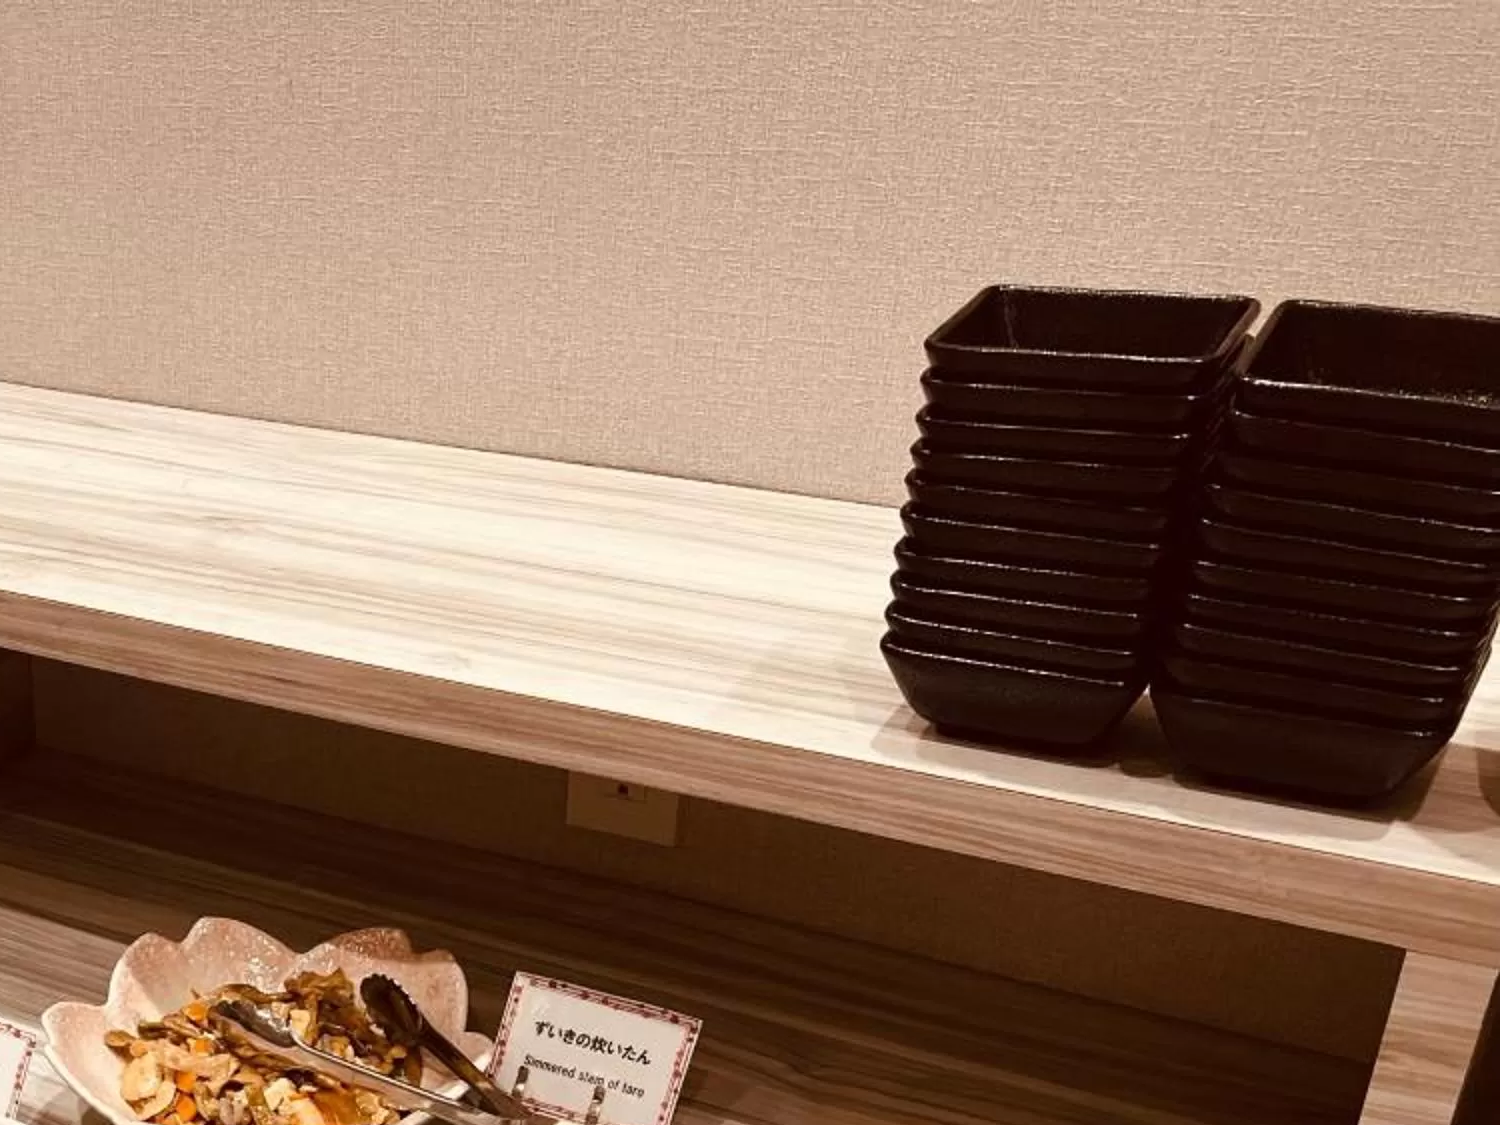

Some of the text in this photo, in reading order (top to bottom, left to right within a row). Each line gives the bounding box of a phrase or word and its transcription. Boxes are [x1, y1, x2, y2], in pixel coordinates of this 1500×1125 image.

[535, 1019, 652, 1066] ずいきの炊いたん
[524, 1054, 645, 1098] Simmered stem of taro
